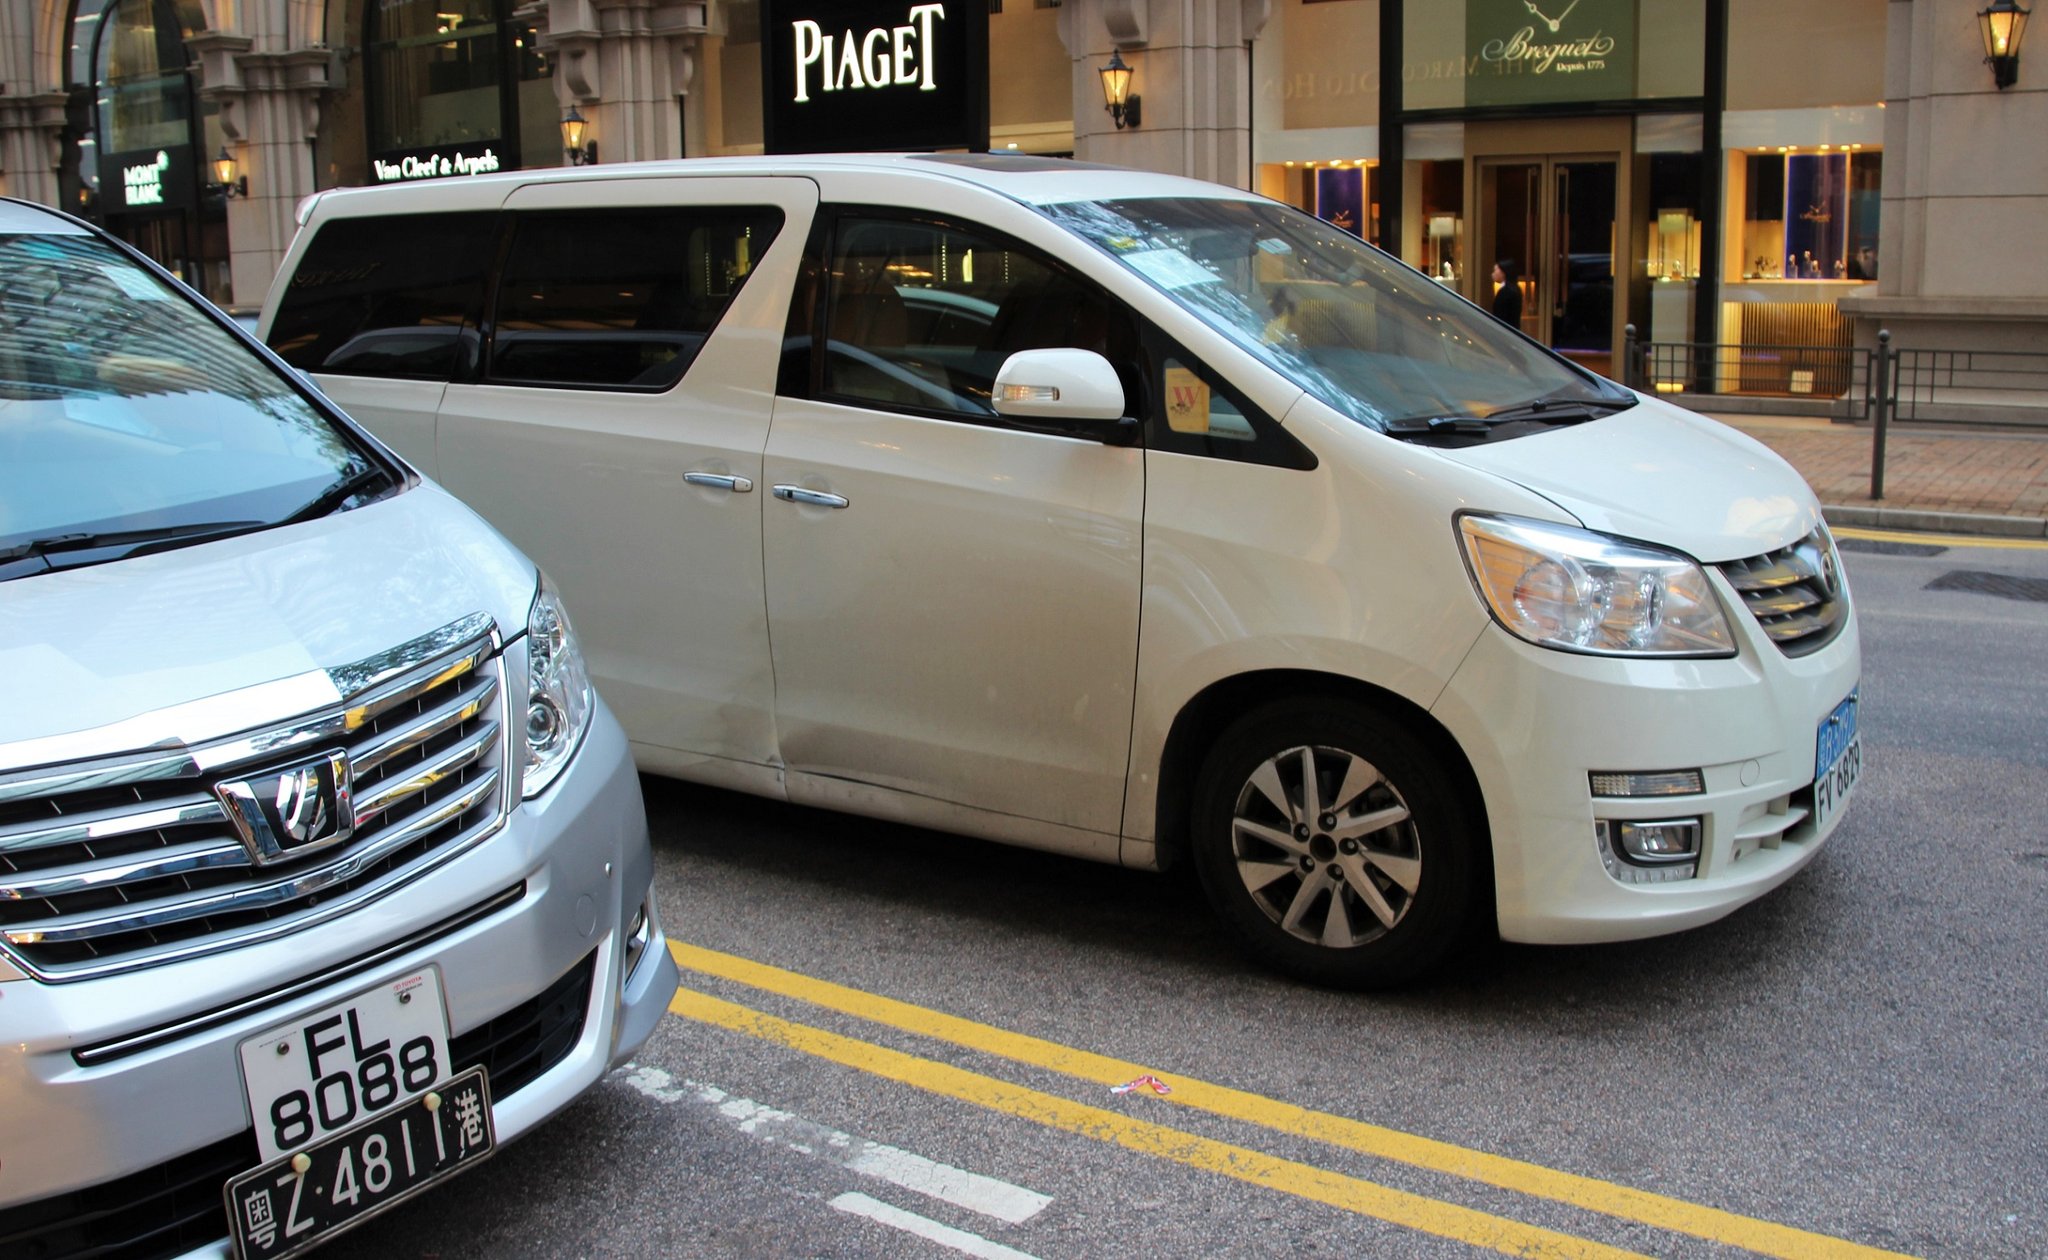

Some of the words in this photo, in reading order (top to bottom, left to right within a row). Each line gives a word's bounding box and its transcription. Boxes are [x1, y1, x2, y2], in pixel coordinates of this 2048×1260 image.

[791, 3, 945, 102] PIAGET
[1482, 26, 1614, 74] Breguet
[1556, 62, 1585, 72] Depuis
[124, 163, 160, 186] MONT
[374, 160, 401, 181] Van
[402, 154, 439, 178] Cleef
[440, 158, 452, 175] &
[454, 149, 499, 177] Arpels
[125, 182, 163, 206] BLANC
[1818, 770, 1835, 823] FV
[1837, 740, 1860, 798] 6829
[303, 1008, 391, 1082] FL
[270, 1035, 438, 1151] 8088
